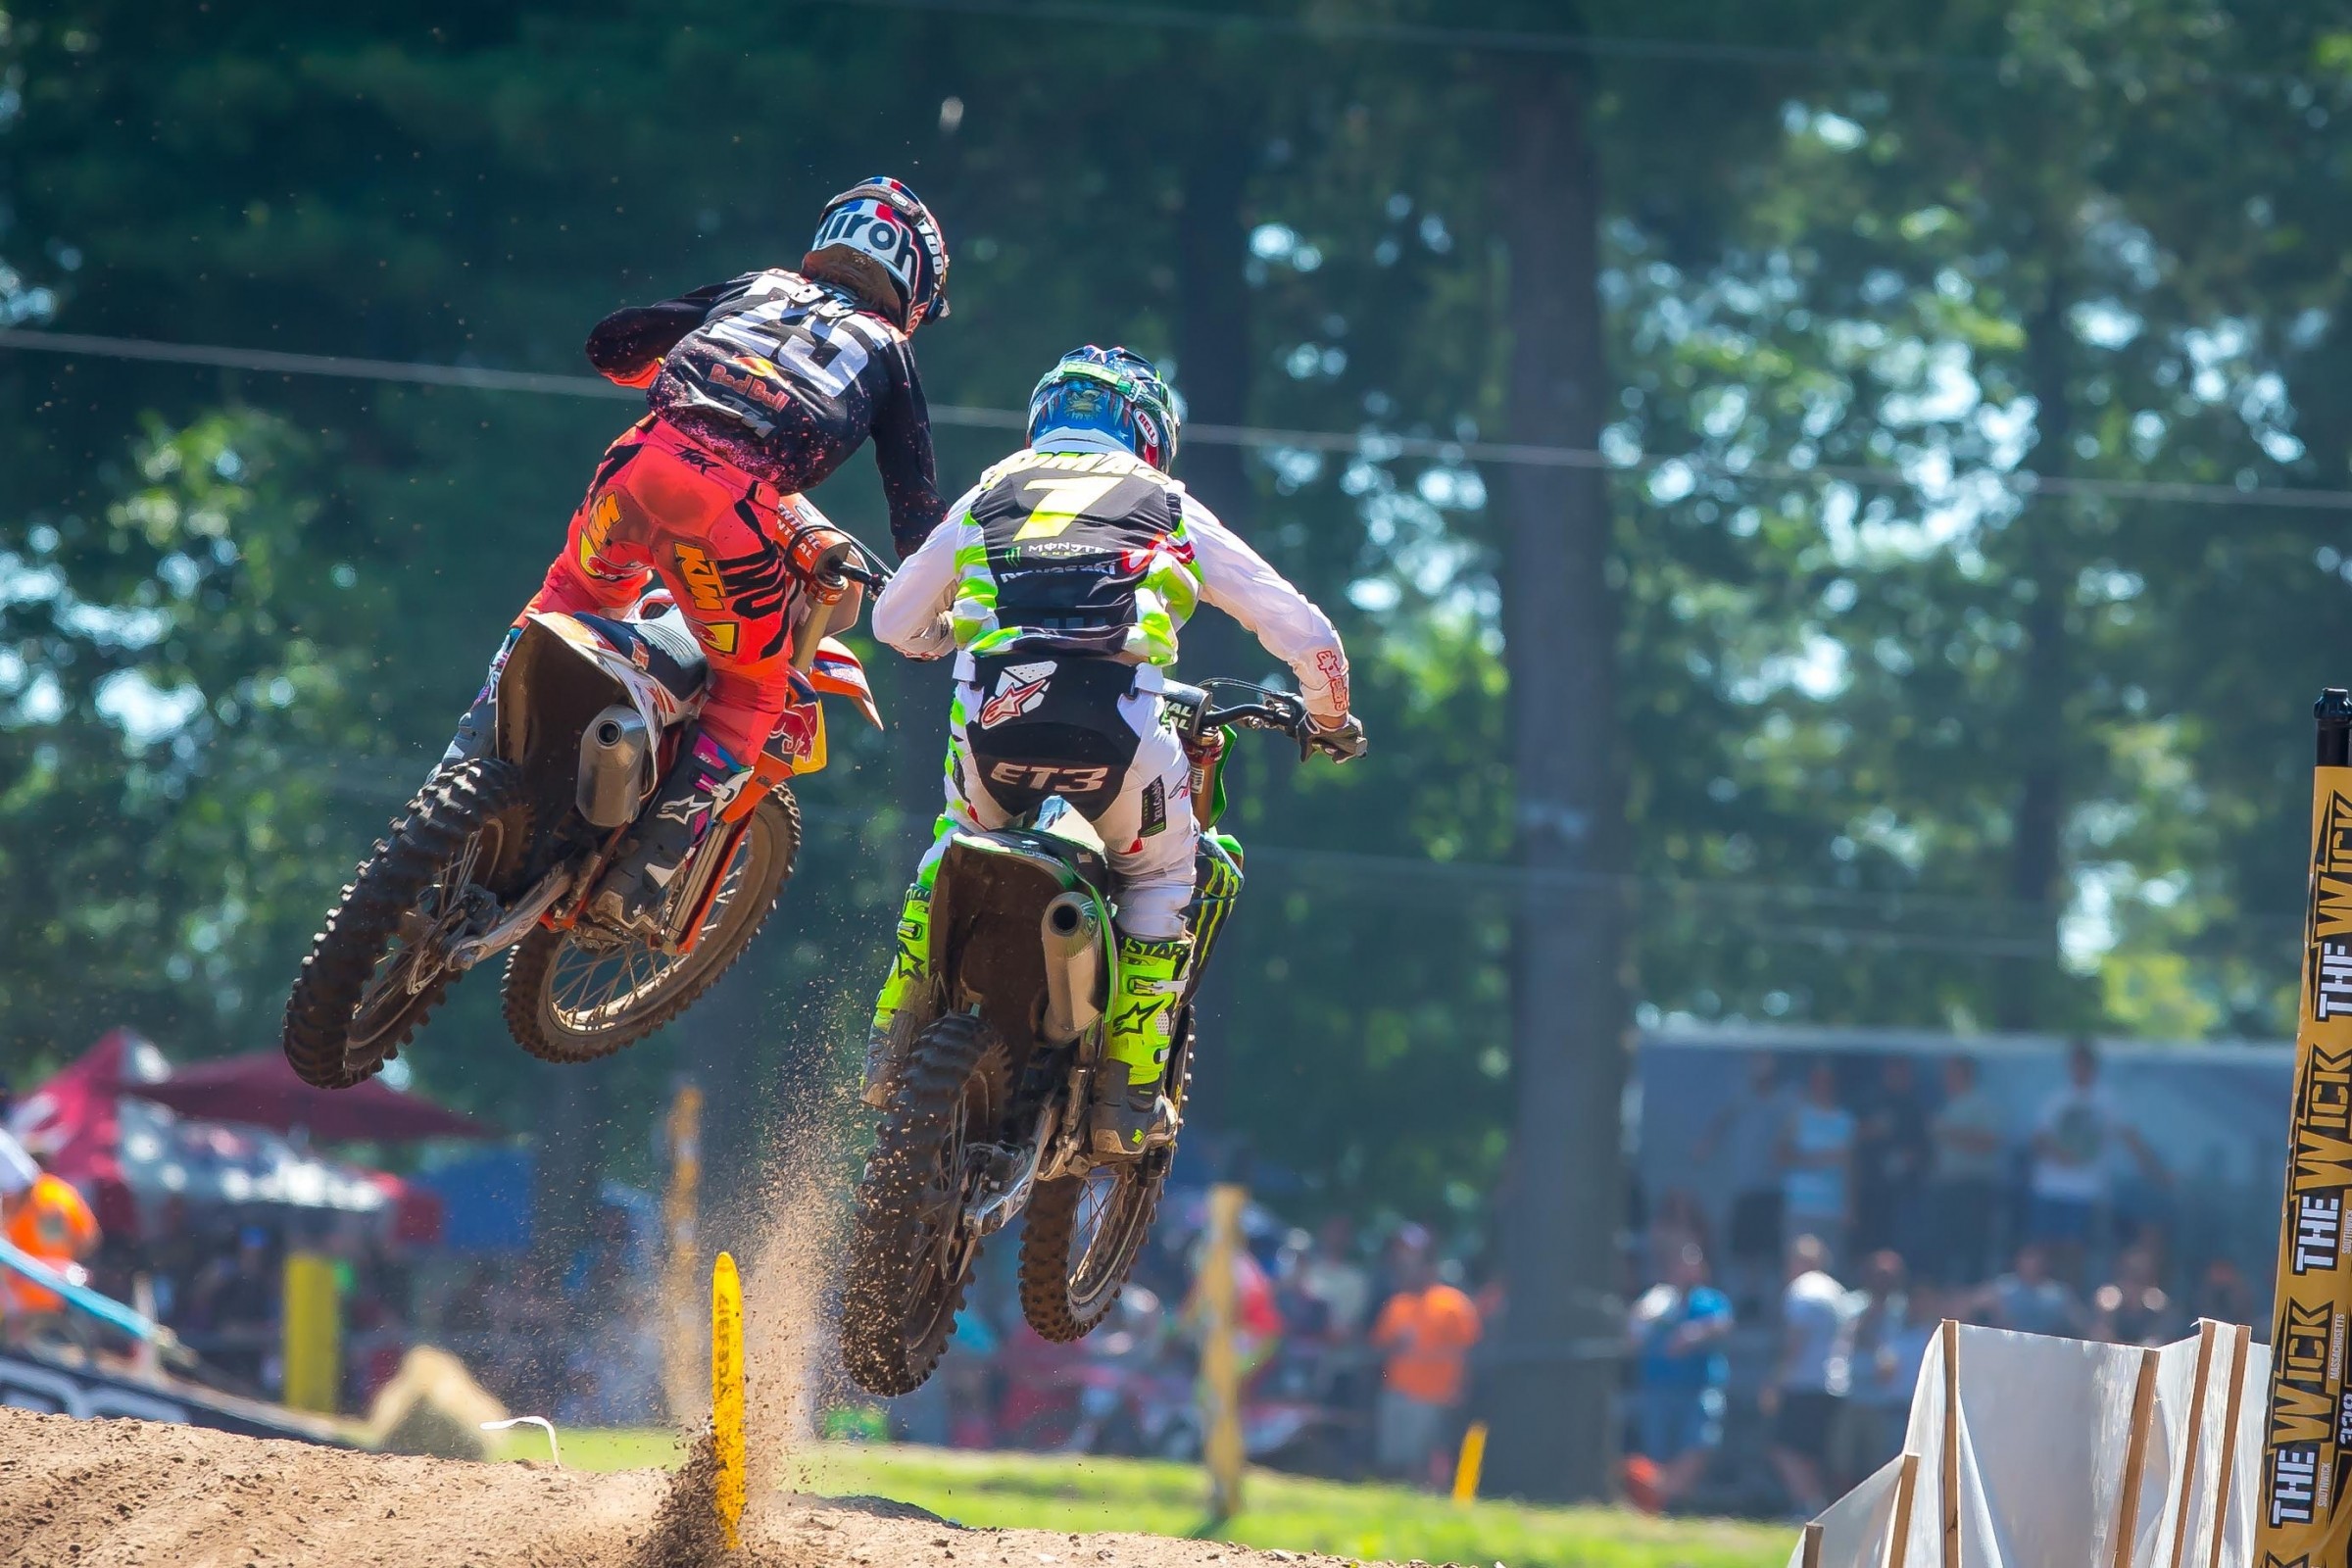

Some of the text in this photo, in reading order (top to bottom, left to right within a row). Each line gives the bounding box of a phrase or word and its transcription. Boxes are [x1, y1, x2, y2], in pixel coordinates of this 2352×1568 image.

[707, 364, 790, 414] Red Bull
[1138, 413, 1156, 442] BELL
[1012, 476, 1125, 542] 7
[673, 542, 728, 612] KTM
[1028, 542, 1113, 555] MONSTE
[990, 761, 1108, 792] ET3
[1152, 778, 1164, 822] MONSTER
[2319, 943, 2352, 1018] THE
[2295, 1053, 2352, 1271] THE WICK
[2273, 1305, 2332, 1445] WICK
[2317, 1313, 2345, 1507] SOUTHWICK MASSACHUSETTS
[2273, 1449, 2315, 1524] THE
